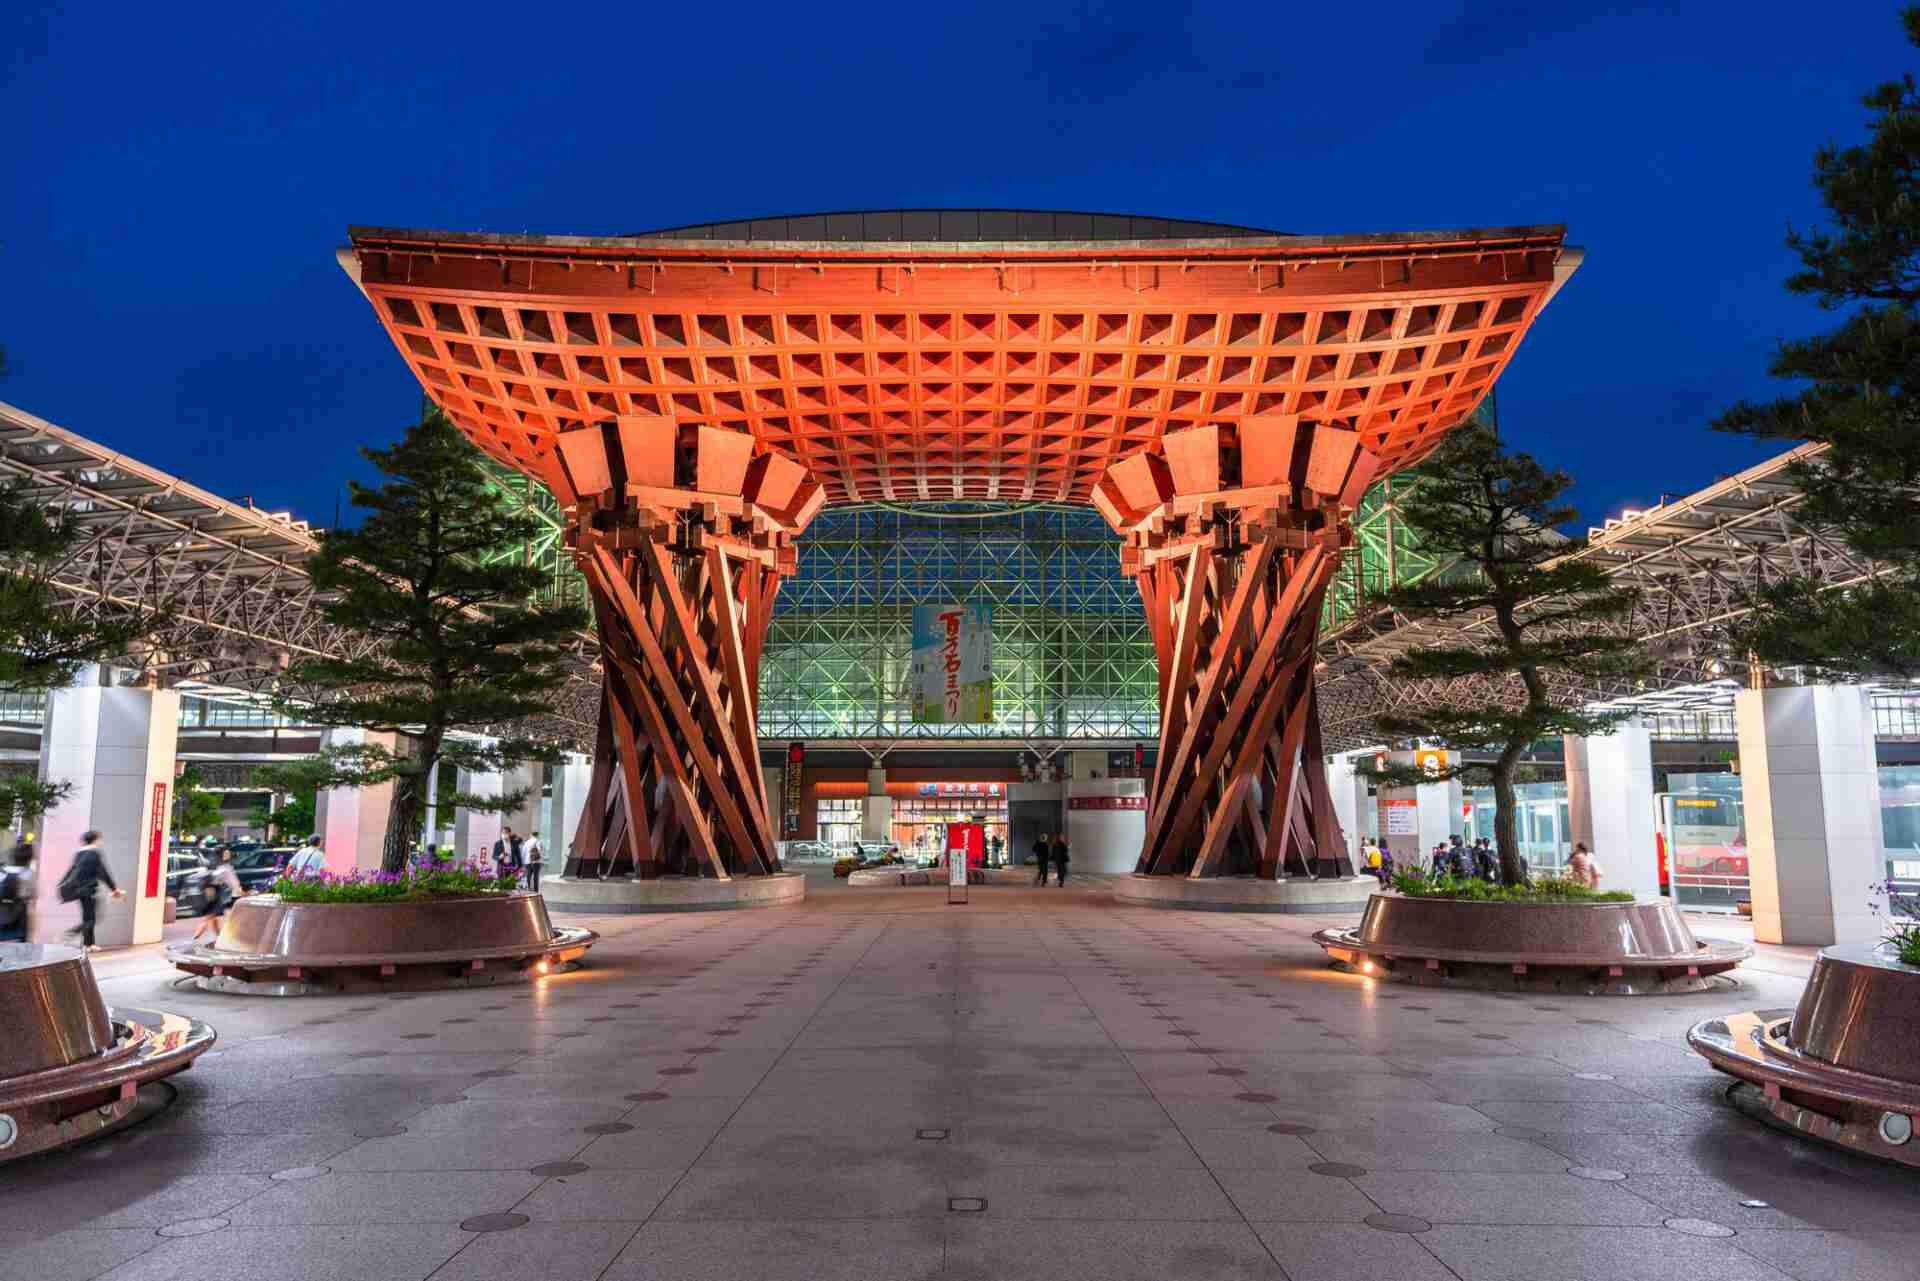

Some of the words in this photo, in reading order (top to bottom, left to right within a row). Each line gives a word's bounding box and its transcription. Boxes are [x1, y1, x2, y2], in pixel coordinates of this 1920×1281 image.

[937, 609, 964, 719] 百万石まつり
